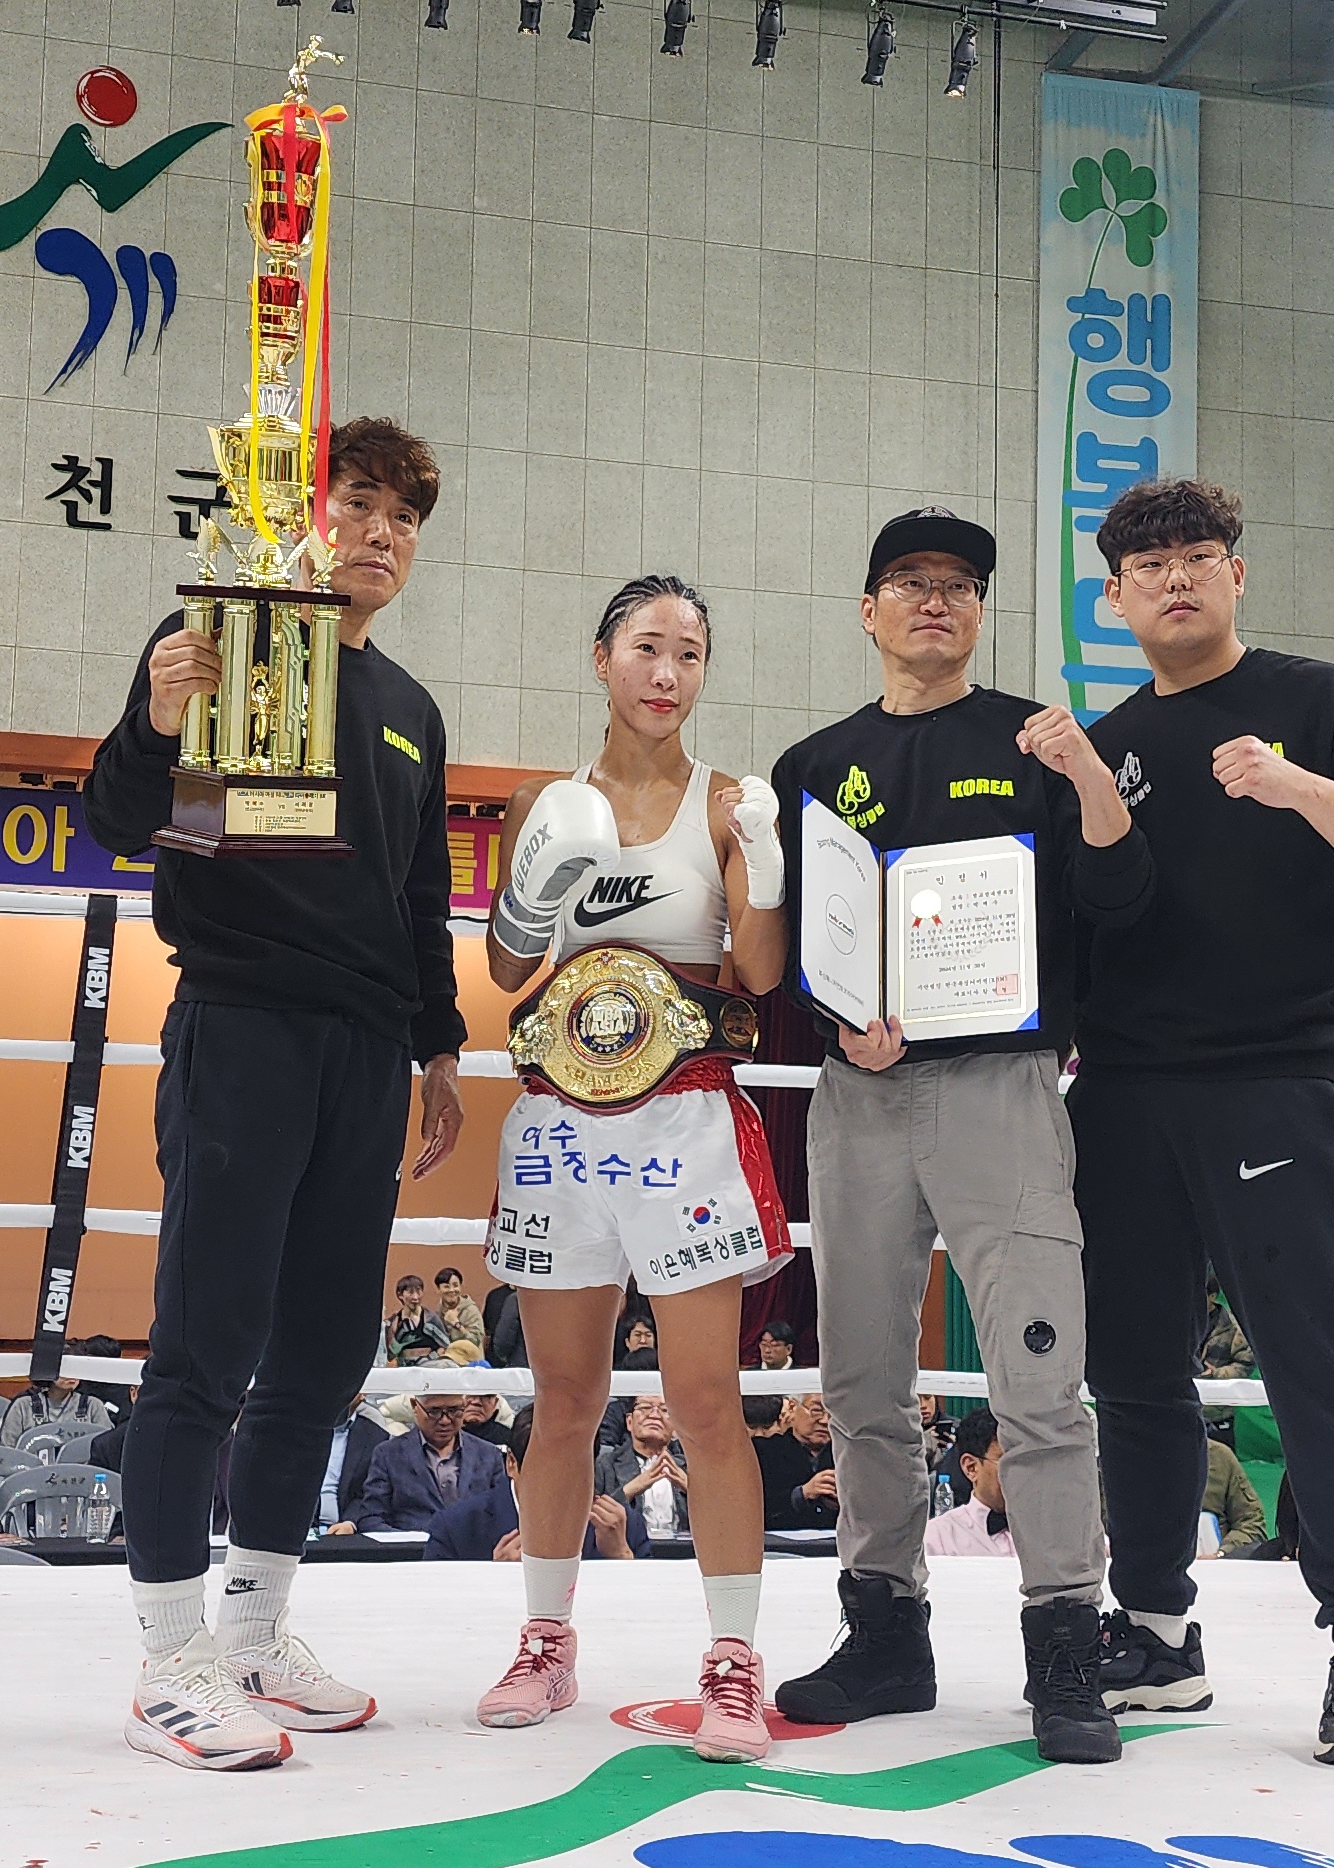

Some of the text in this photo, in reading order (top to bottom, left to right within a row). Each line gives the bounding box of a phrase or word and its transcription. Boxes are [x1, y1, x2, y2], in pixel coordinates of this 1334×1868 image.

[383, 725, 422, 764] KOREA
[949, 778, 1014, 799] KOREA
[513, 821, 554, 895] WEBOX
[586, 874, 654, 904] NIKE
[84, 946, 111, 1008] KBM
[67, 1105, 95, 1169] KBM
[522, 1120, 578, 1150] 여수
[43, 1266, 73, 1334] KBM
[228, 1577, 259, 1590] NIKE
